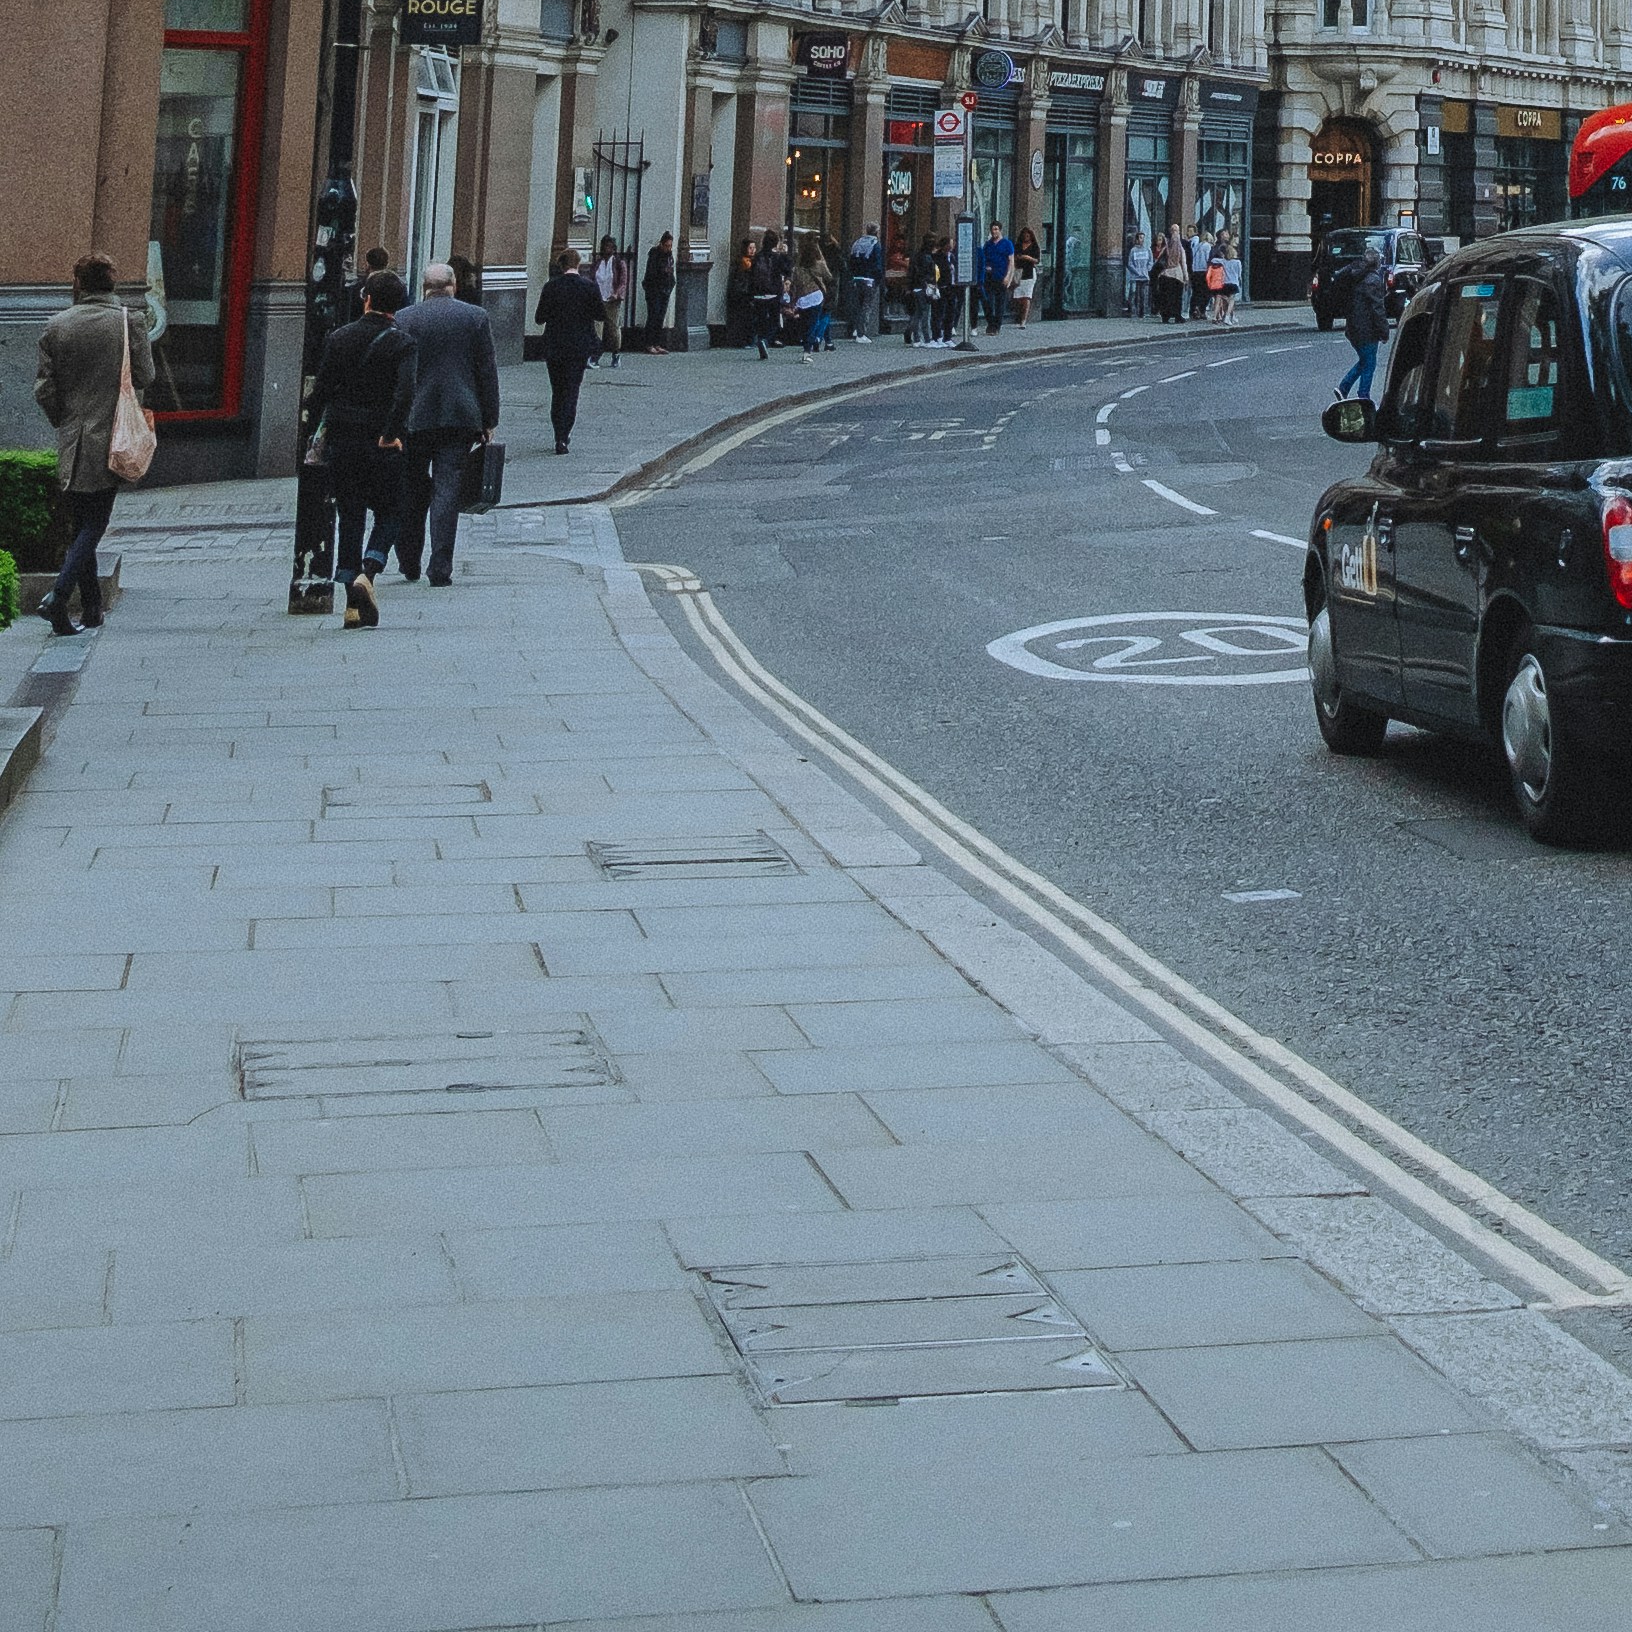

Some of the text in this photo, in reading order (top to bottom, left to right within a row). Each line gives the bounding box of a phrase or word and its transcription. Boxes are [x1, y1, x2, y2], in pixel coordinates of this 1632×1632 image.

[408, 0, 477, 15] ROUGE
[810, 45, 845, 59] SOHO
[1517, 110, 1542, 127] COPPA
[1314, 152, 1362, 165] COPPA
[1611, 176, 1627, 190] 76
